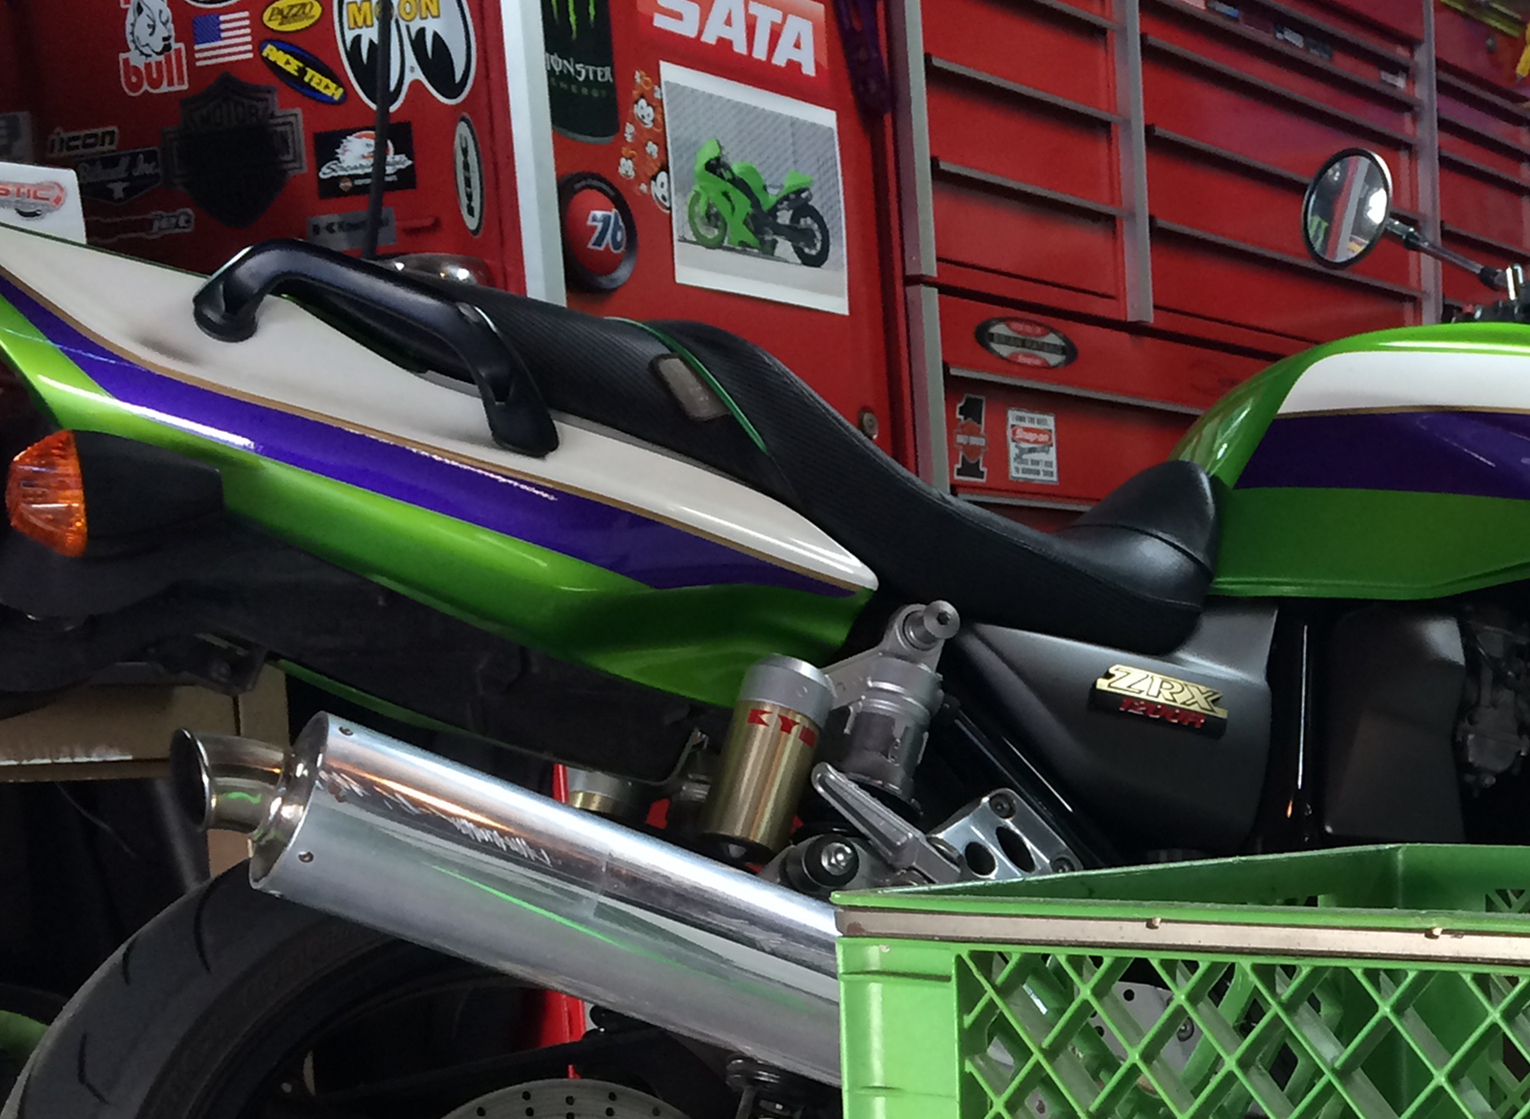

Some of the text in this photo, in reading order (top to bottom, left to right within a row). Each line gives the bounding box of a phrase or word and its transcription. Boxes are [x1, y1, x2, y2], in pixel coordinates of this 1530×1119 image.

[653, 0, 817, 77] SATA
[122, 47, 184, 94] bull
[261, 43, 345, 101] RACE TECH
[586, 208, 627, 254] 76
[1109, 667, 1219, 713] ZRX
[1119, 697, 1207, 729] 1200R
